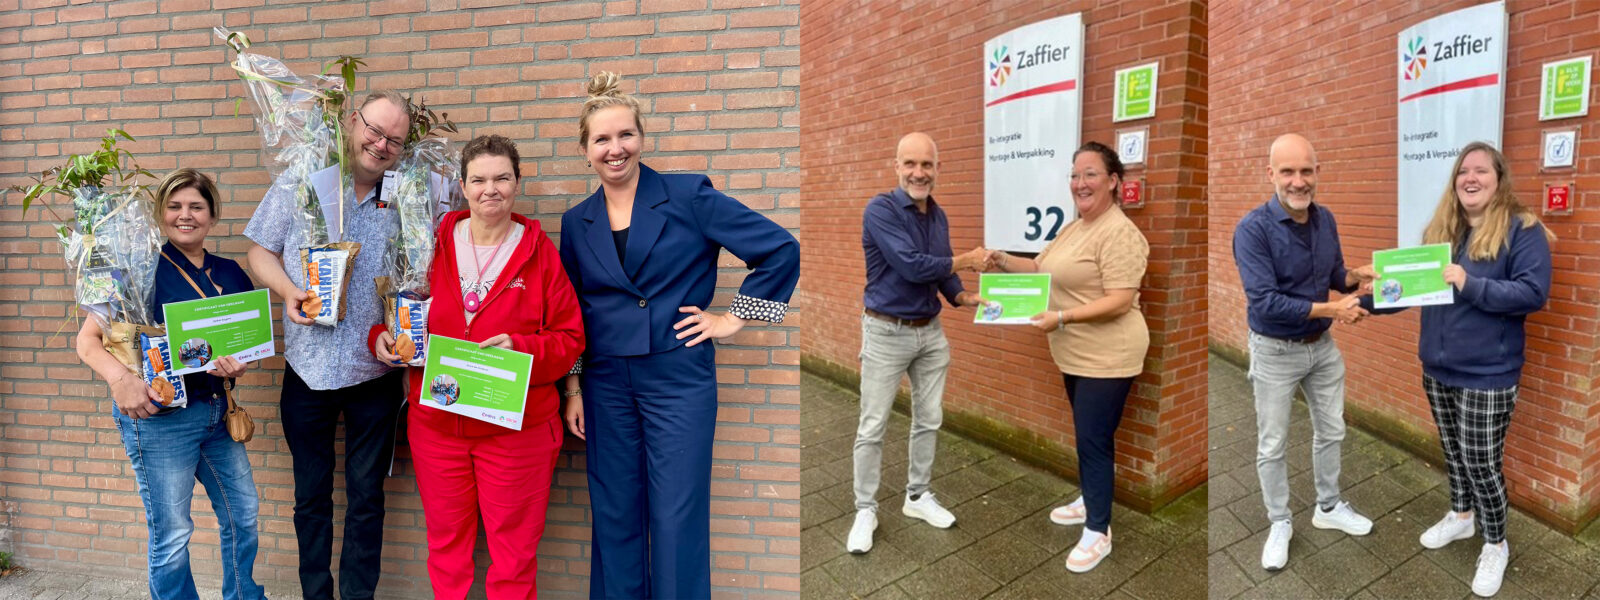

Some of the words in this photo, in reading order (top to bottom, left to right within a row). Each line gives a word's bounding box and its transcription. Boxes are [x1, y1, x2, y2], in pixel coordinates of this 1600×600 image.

[1016, 44, 1071, 70] Zaffier
[1433, 34, 1493, 62] Zaffier
[1011, 151, 1015, 159] &
[1016, 148, 1055, 160] Verpakking
[1426, 150, 1431, 159] &
[1024, 206, 1065, 241] 32
[318, 258, 332, 317] KANJERS
[408, 303, 425, 360] KANJERS
